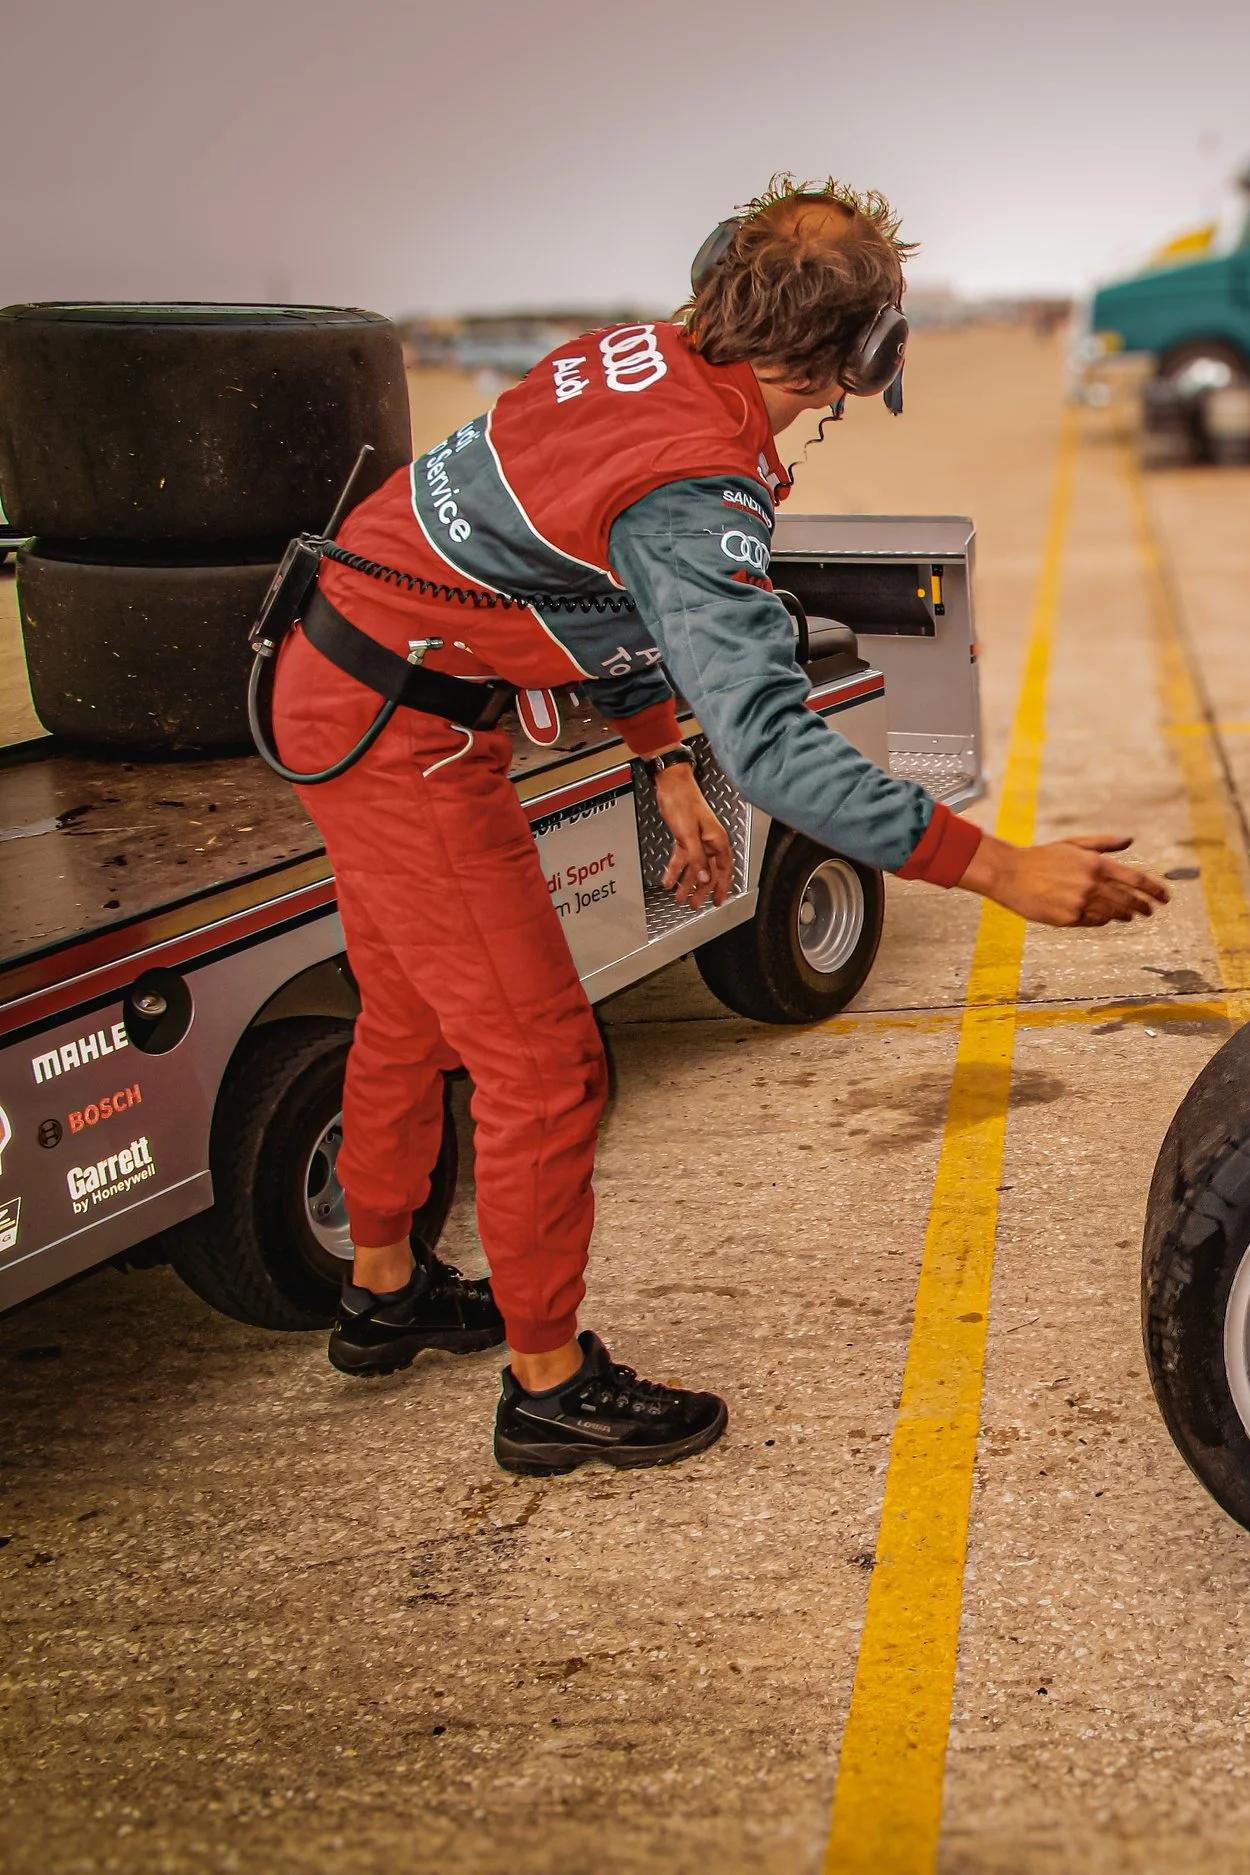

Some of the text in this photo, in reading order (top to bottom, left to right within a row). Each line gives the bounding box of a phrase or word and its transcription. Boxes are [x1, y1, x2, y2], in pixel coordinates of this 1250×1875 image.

[552, 356, 590, 404] Audi
[456, 420, 481, 453] udi
[426, 448, 472, 543] Service
[566, 852, 616, 886] Sport
[574, 879, 617, 914] Joest
[31, 1021, 130, 1084] MAHLE
[67, 1083, 143, 1135] BOSCH
[66, 1136, 153, 1200] Garrett
[72, 1163, 156, 1215] by Honeywell
